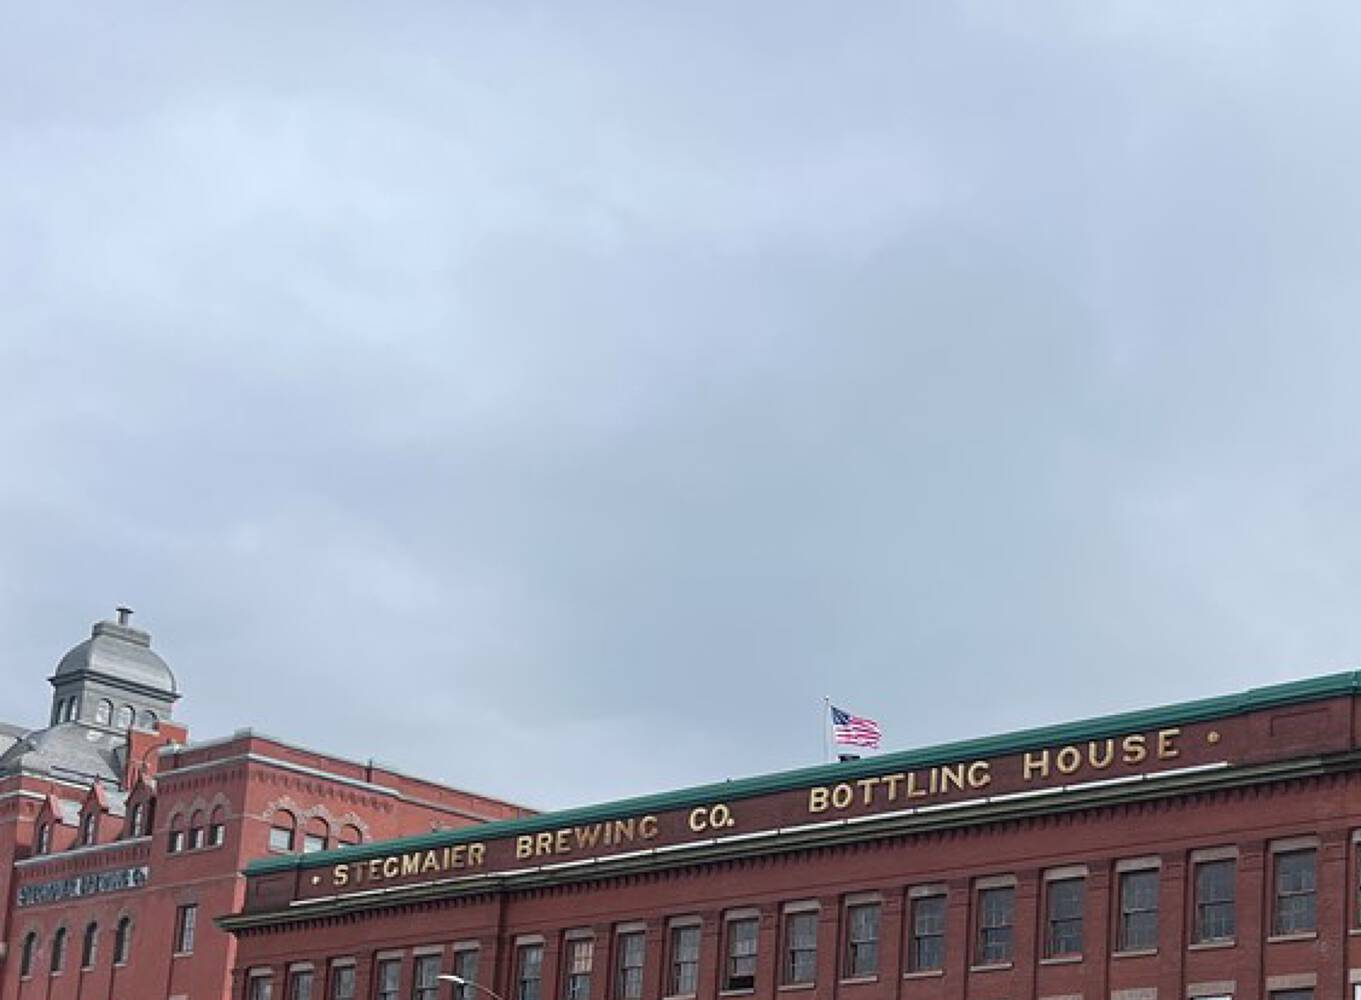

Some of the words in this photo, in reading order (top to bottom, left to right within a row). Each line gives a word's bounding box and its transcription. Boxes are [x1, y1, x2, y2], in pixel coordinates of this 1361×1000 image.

[333, 843, 485, 885] STEGMAIER
[517, 816, 658, 859] BREWING
[690, 804, 735, 832] CO.
[808, 761, 991, 813] BOTTLING
[1023, 729, 1181, 779] HOUSE
